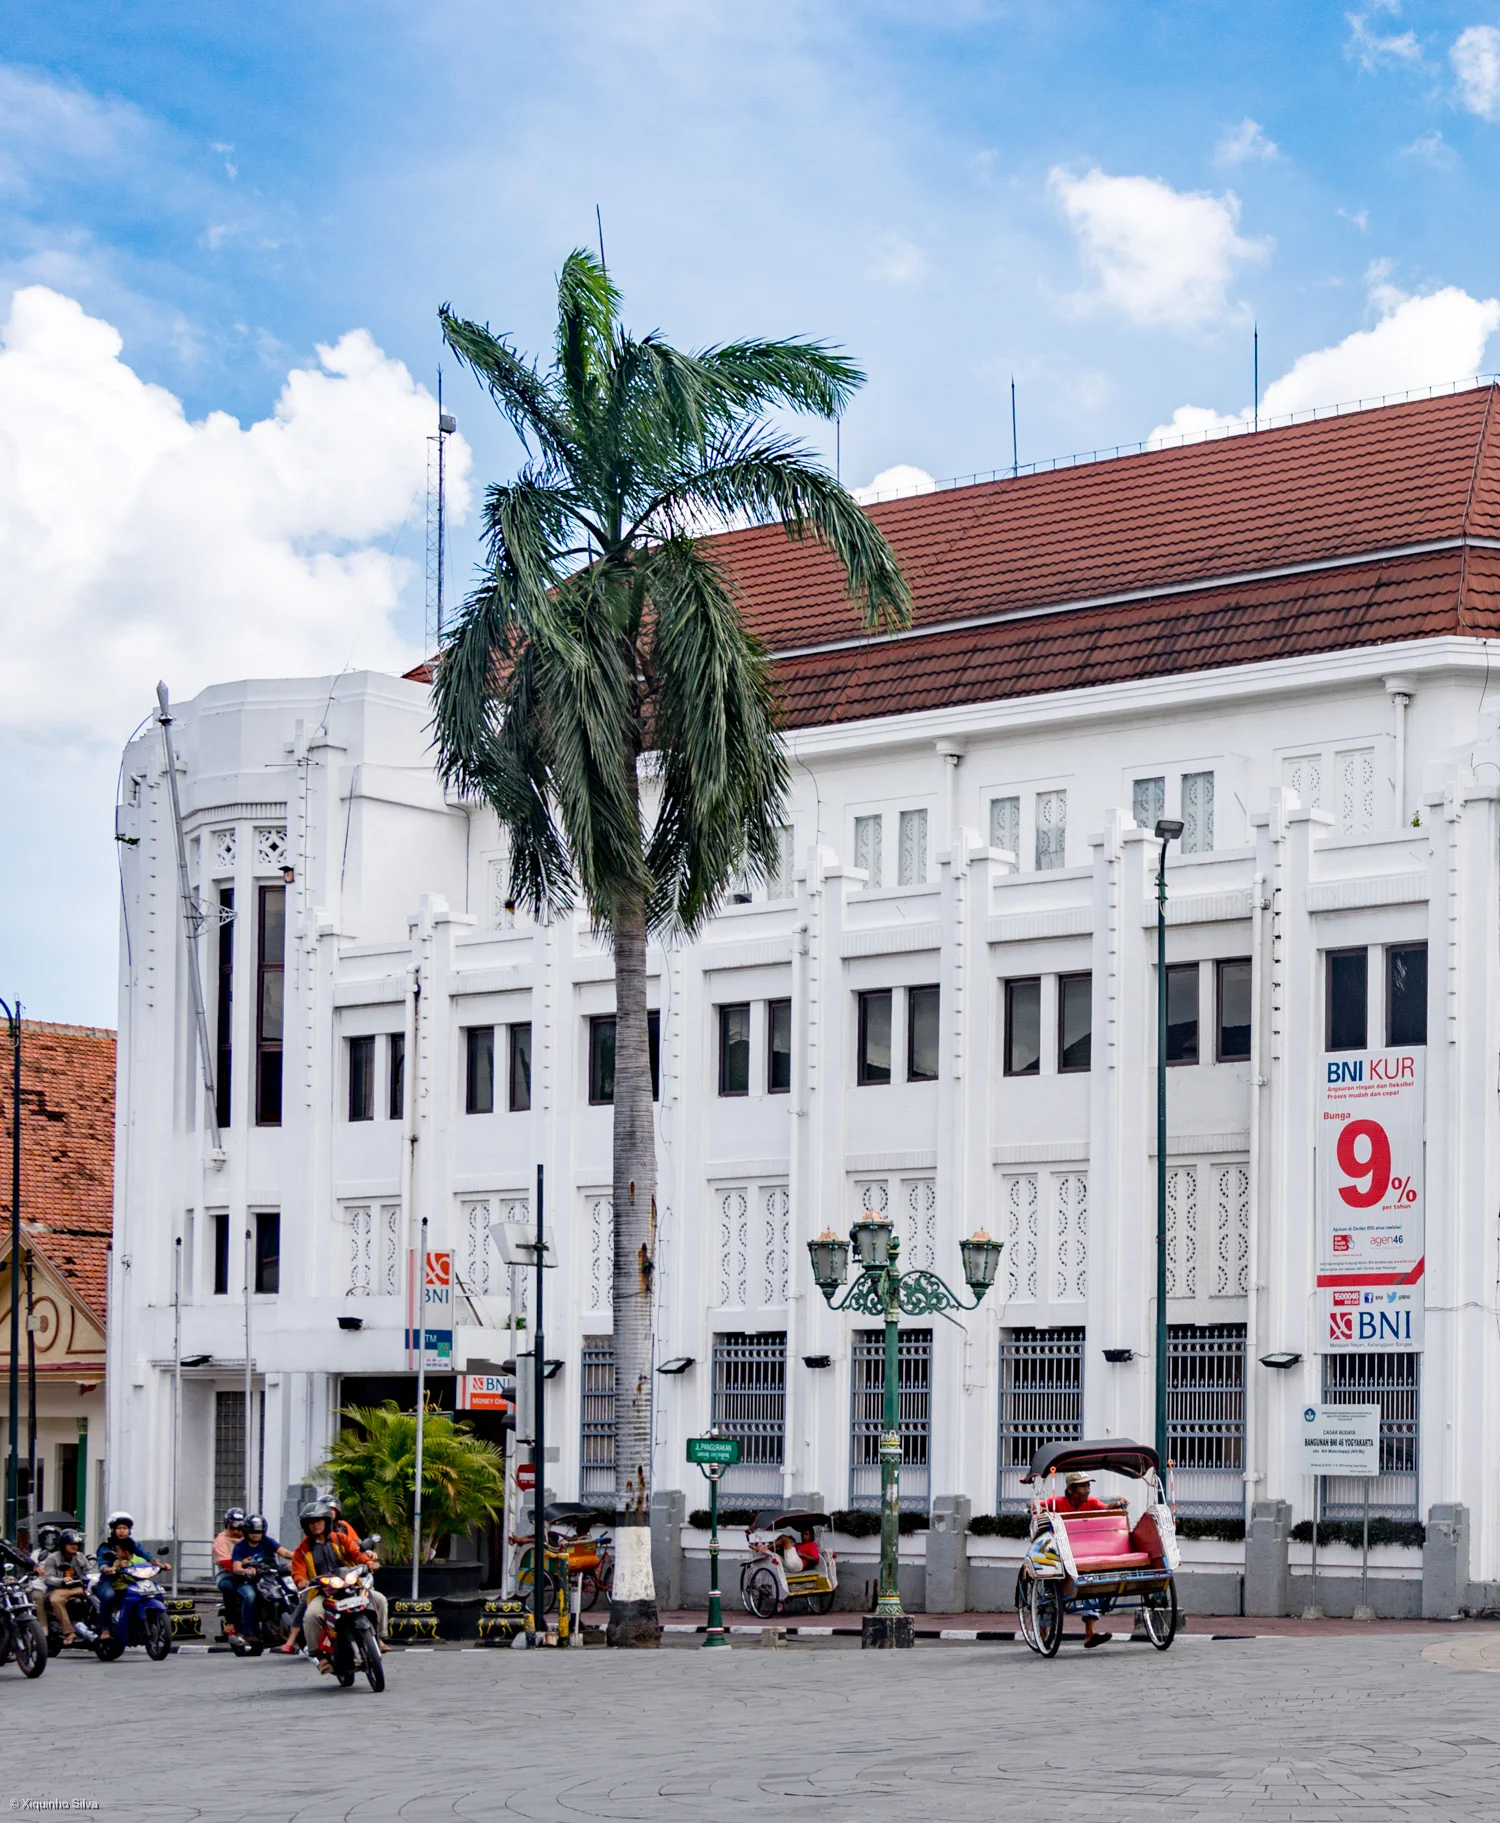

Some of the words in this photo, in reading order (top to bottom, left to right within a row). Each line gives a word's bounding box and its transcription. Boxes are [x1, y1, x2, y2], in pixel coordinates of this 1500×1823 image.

[1328, 1060, 1363, 1083] BNI
[1370, 1056, 1414, 1081] KUR
[1323, 1112, 1351, 1121] Bunga
[1370, 1235, 1404, 1246] agen46
[1359, 1311, 1411, 1340] BNI
[1305, 1438, 1329, 1447] BANGUNAN
[1330, 1439, 1338, 1447] BNI
[1338, 1439, 1344, 1447] 46
[1345, 1438, 1374, 1447] YOGYAKARTA
